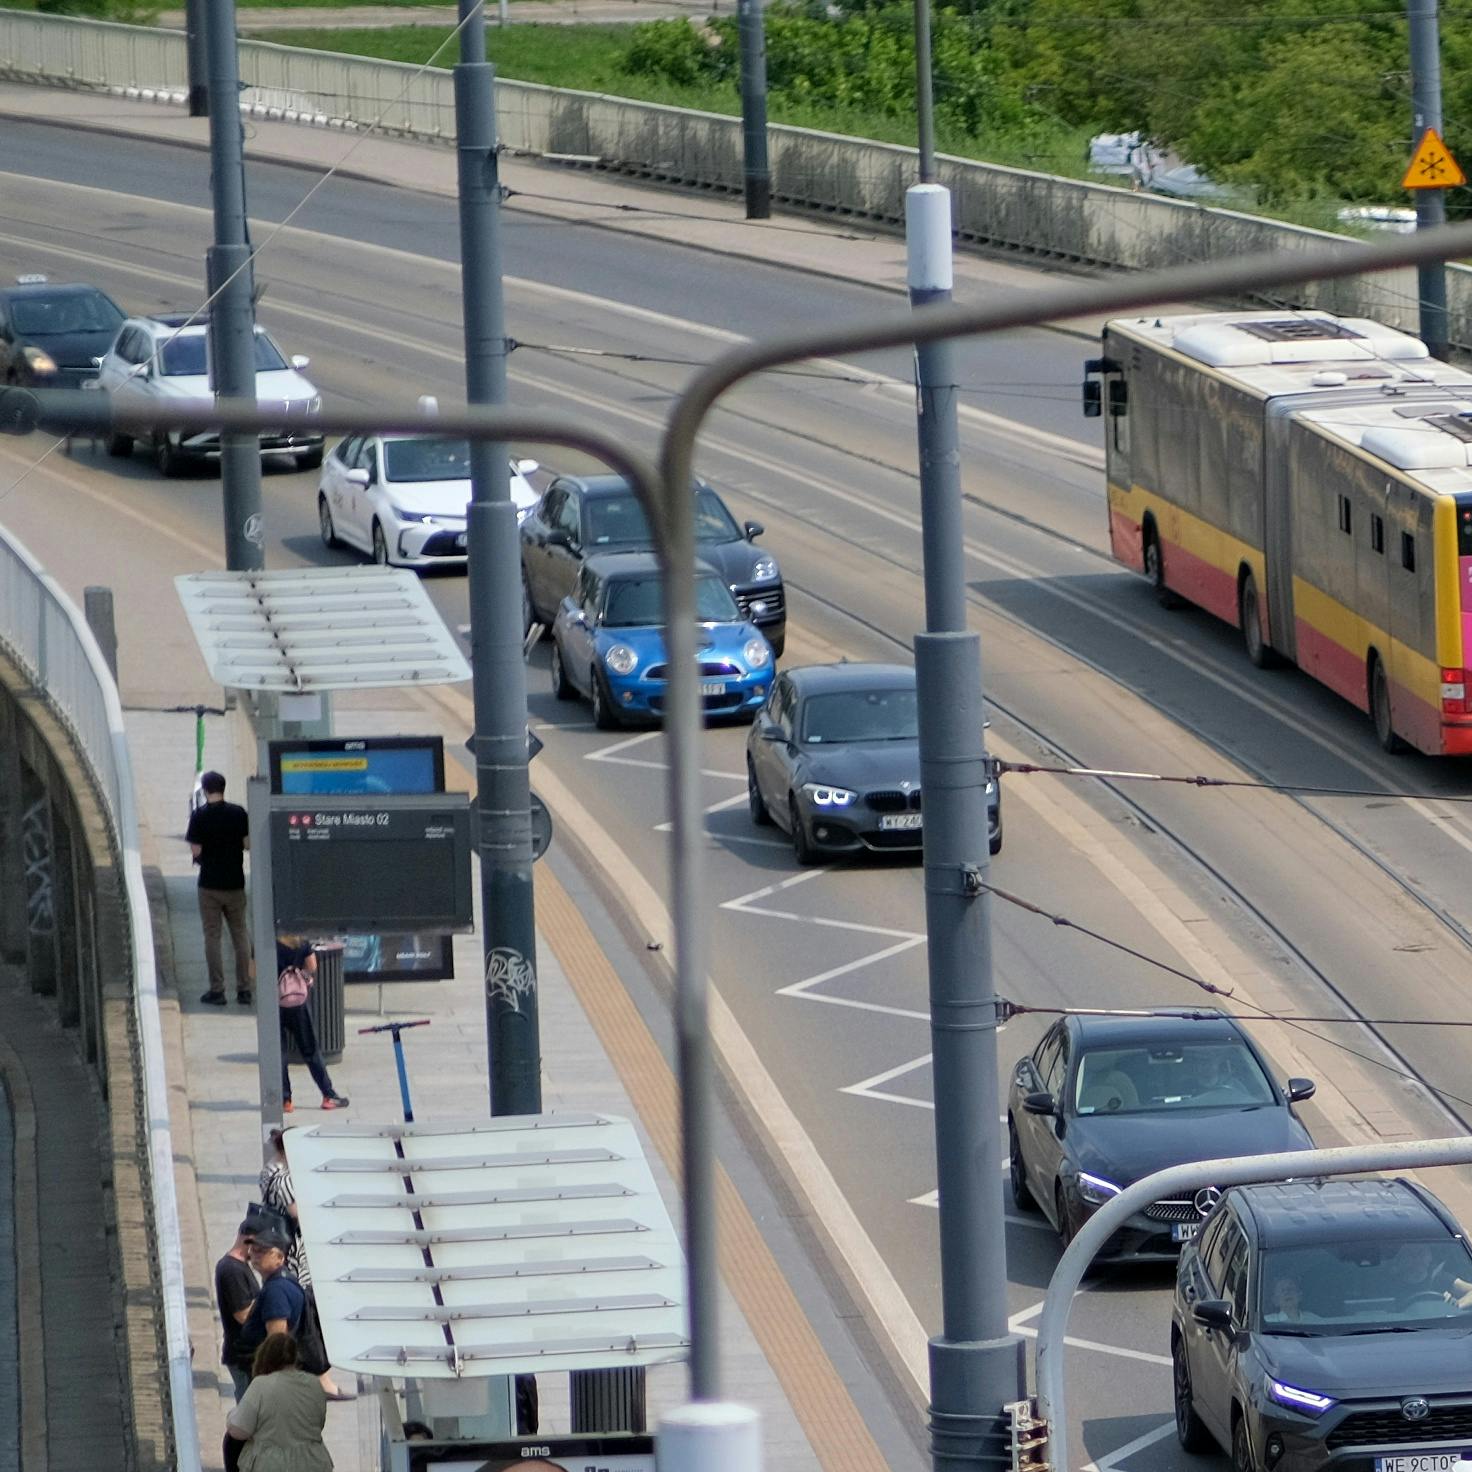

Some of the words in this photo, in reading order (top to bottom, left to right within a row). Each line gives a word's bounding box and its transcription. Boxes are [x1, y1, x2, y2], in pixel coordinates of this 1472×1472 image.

[314, 813, 341, 826] Stare
[342, 813, 375, 826] Miasto
[376, 812, 390, 825] 02
[520, 1446, 551, 1458] ams
[1385, 1458, 1405, 1472] WE
